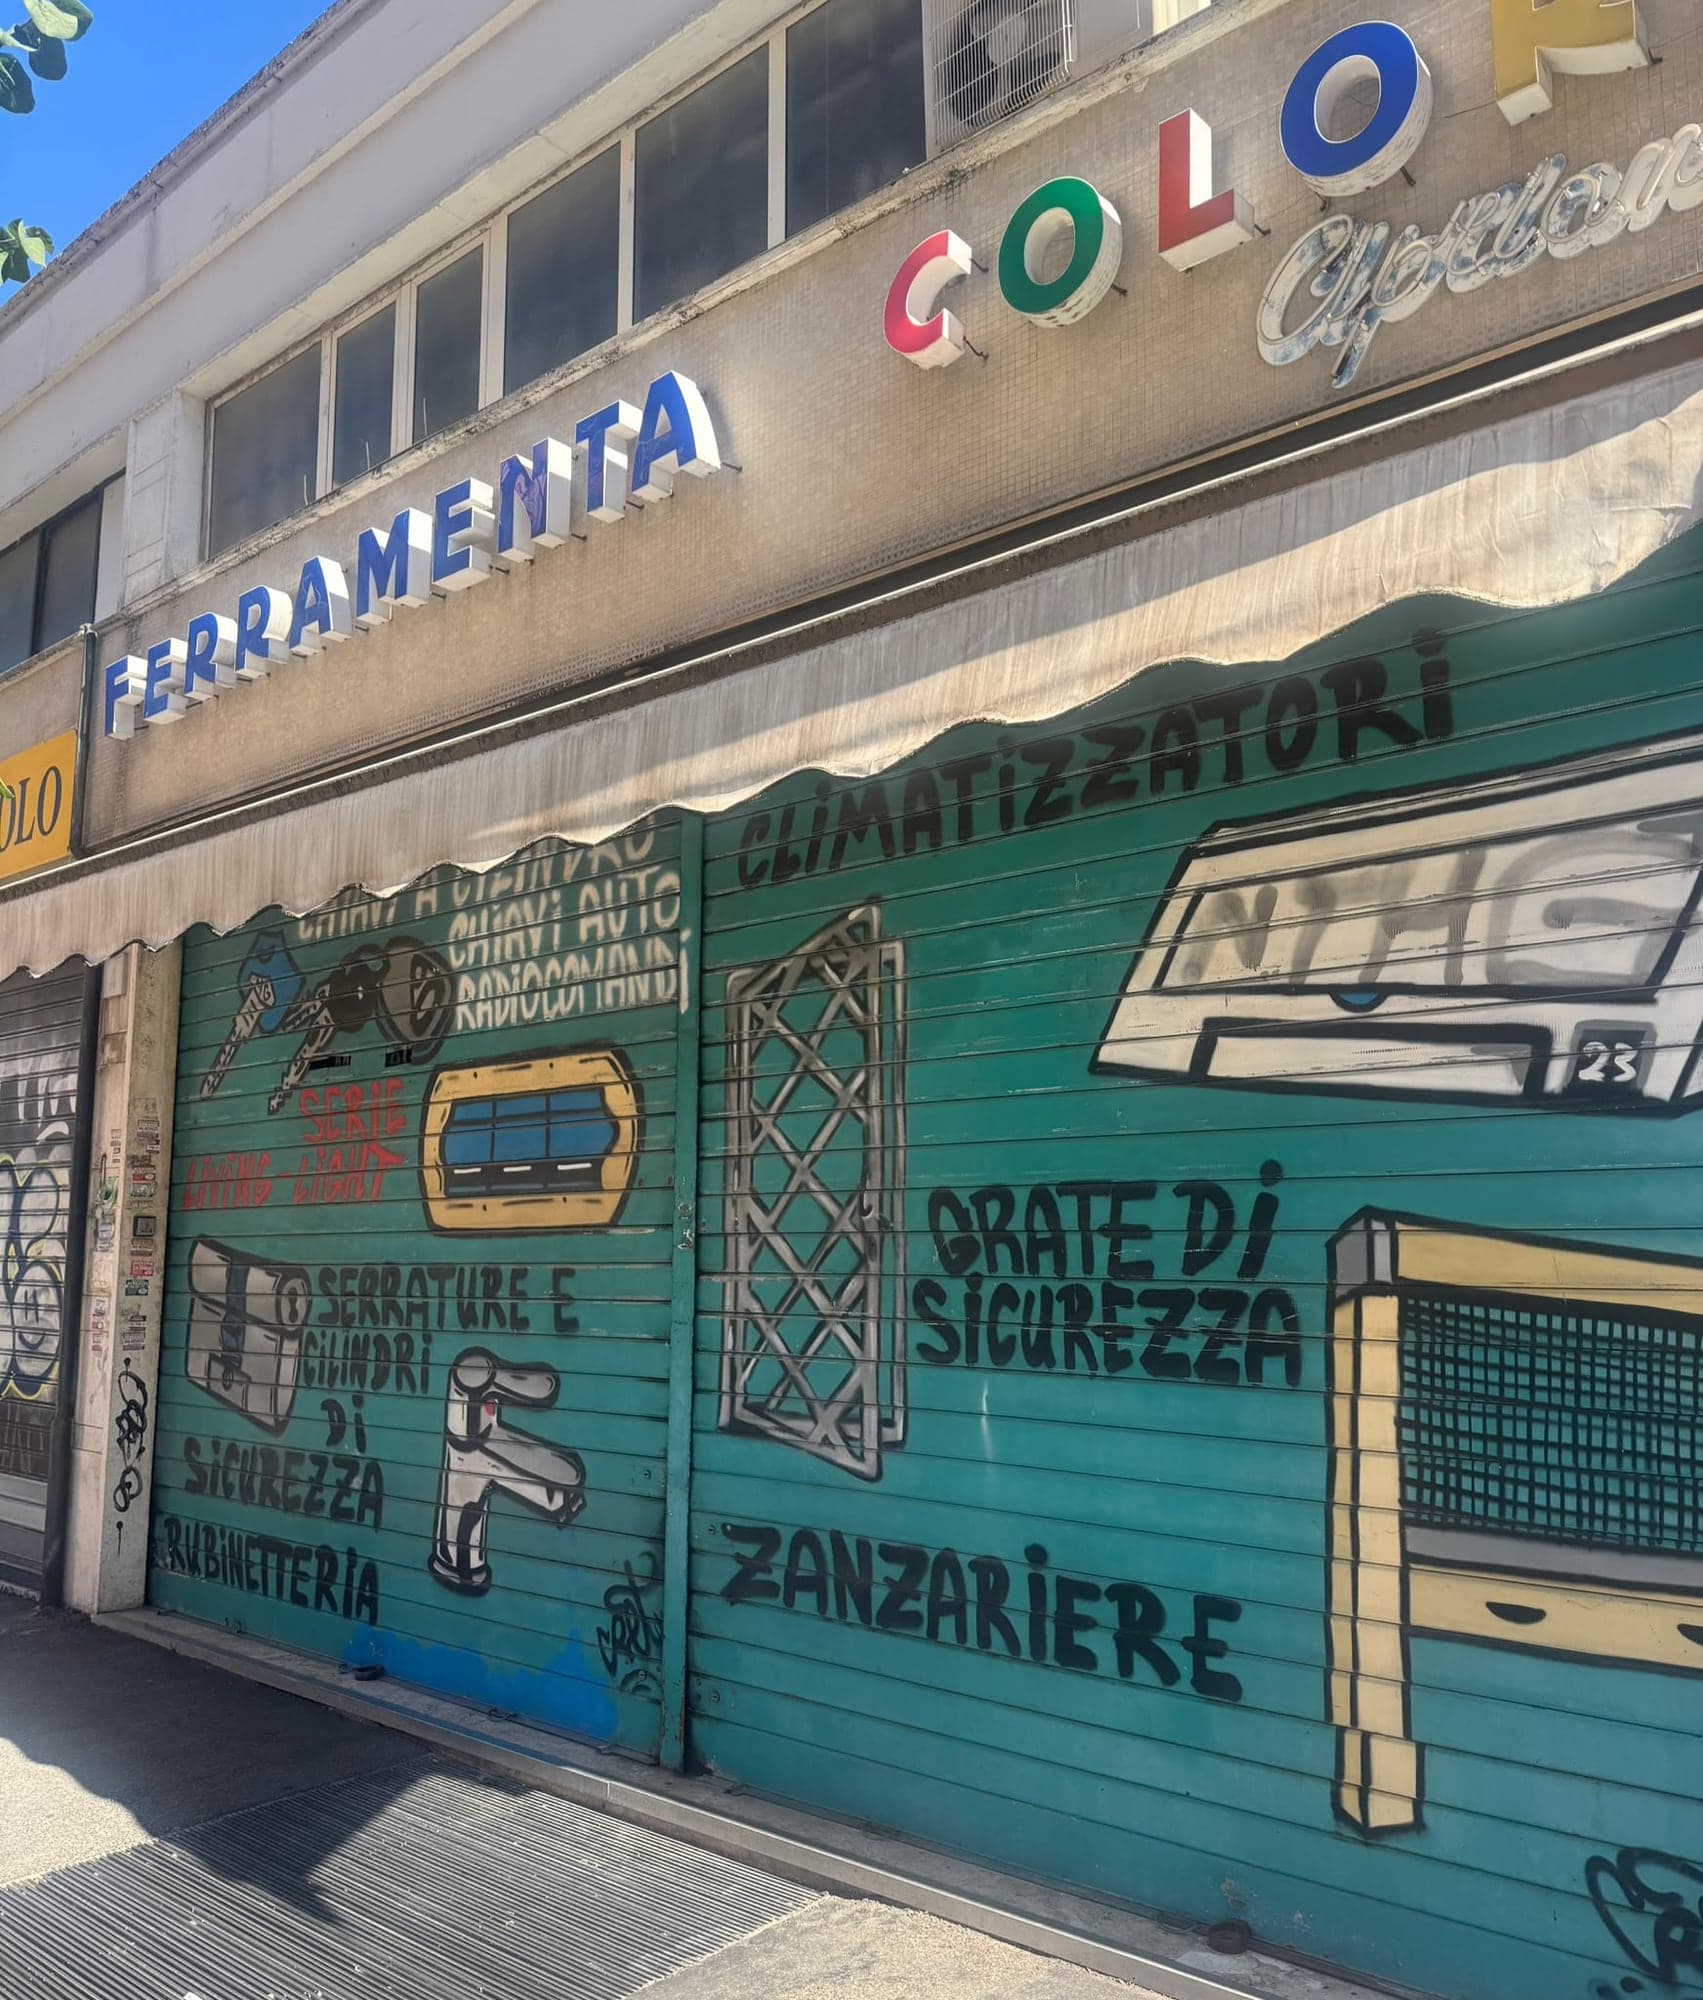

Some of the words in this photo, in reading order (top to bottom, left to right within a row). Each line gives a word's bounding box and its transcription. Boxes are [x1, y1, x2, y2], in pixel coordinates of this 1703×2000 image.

[104, 370, 721, 740] FERRAMENTA
[578, 864, 681, 944] AUTO
[1577, 1041, 1638, 1083] 23
[927, 1180, 1158, 1280] GRATE
[318, 1263, 531, 1331] SERRATURE
[551, 1267, 581, 1334] E
